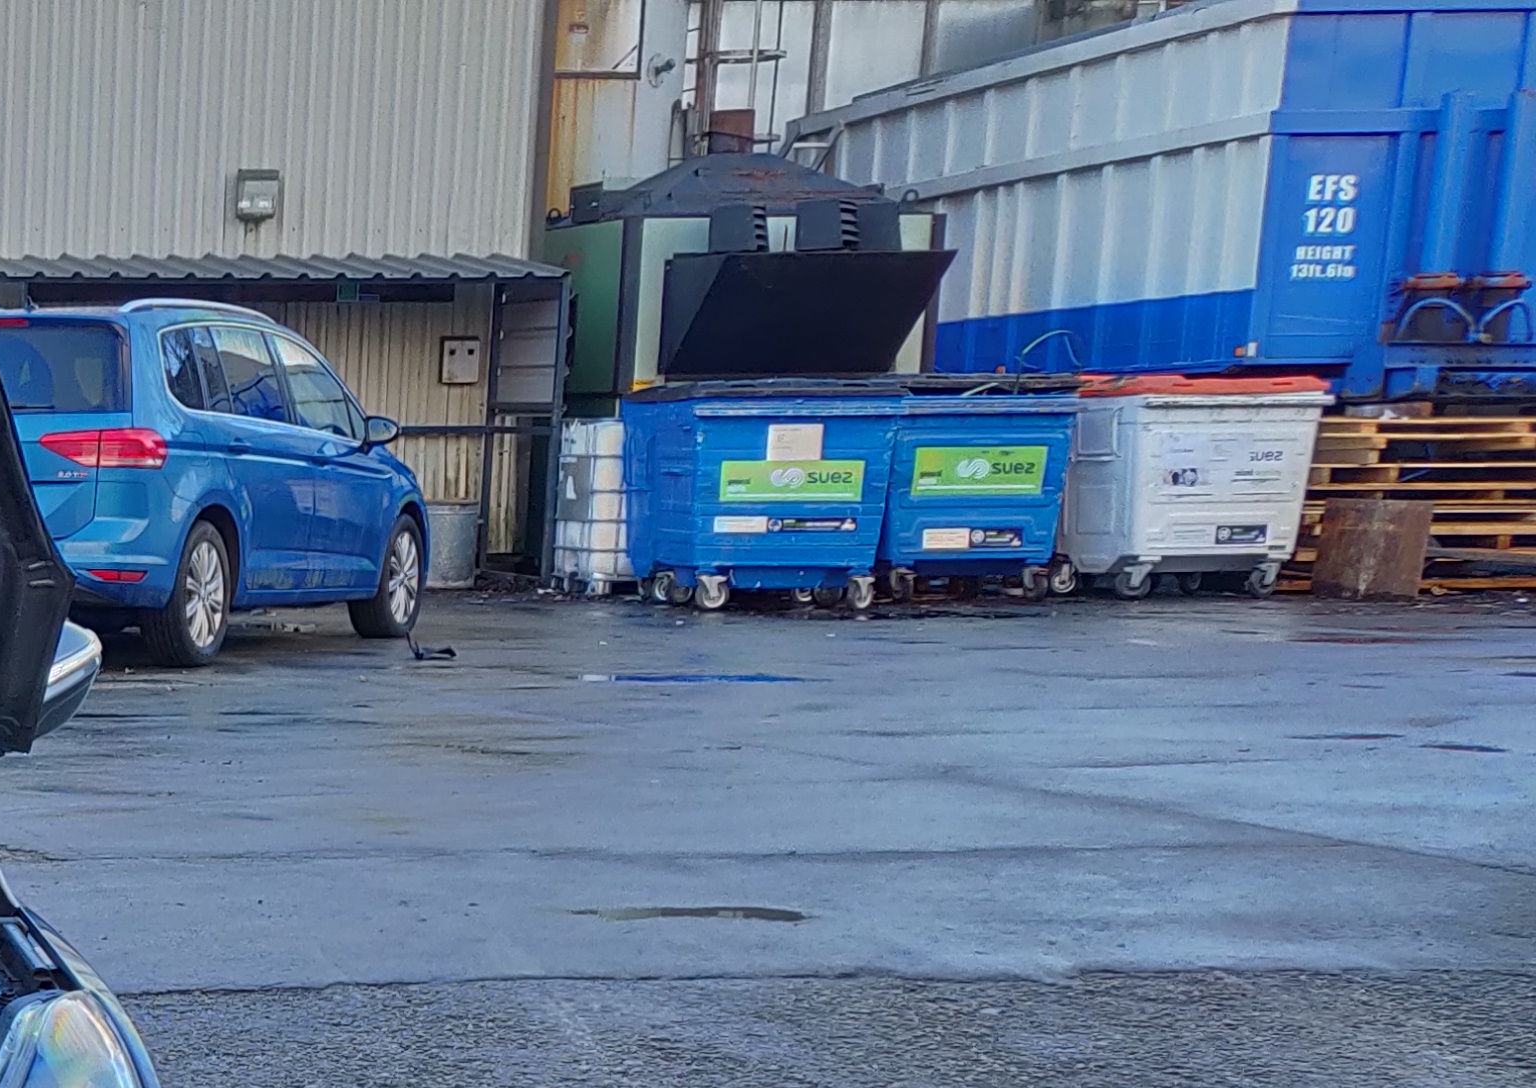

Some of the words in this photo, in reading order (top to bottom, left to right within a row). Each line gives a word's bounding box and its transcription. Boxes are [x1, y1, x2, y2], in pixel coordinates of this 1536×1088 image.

[1308, 174, 1359, 202] EFS
[1304, 206, 1356, 234] 120
[1295, 245, 1357, 261] HEIGHT
[990, 461, 1036, 475] suez
[806, 470, 854, 484] suez
